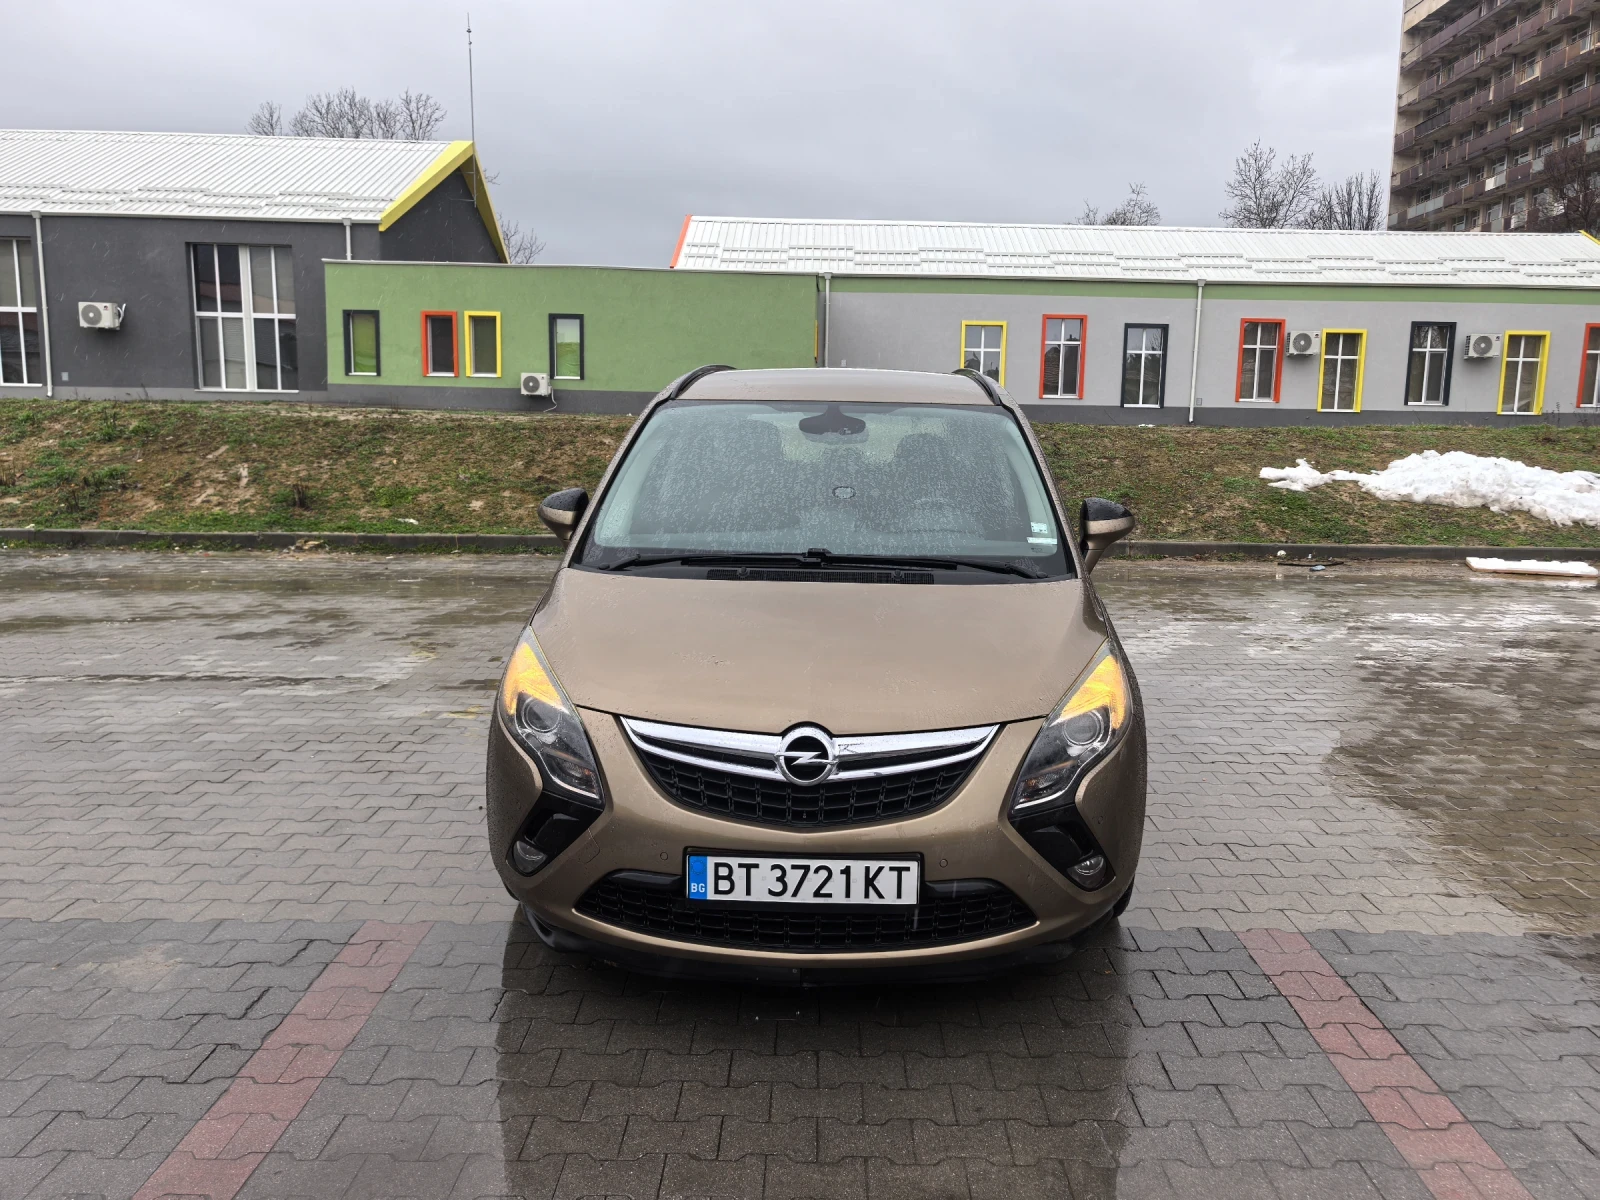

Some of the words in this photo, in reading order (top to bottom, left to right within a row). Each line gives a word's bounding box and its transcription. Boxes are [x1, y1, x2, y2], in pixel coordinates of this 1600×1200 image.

[690, 883, 706, 893] BG
[713, 862, 760, 897] BT
[767, 863, 852, 899] 3721
[863, 865, 911, 900] KT
